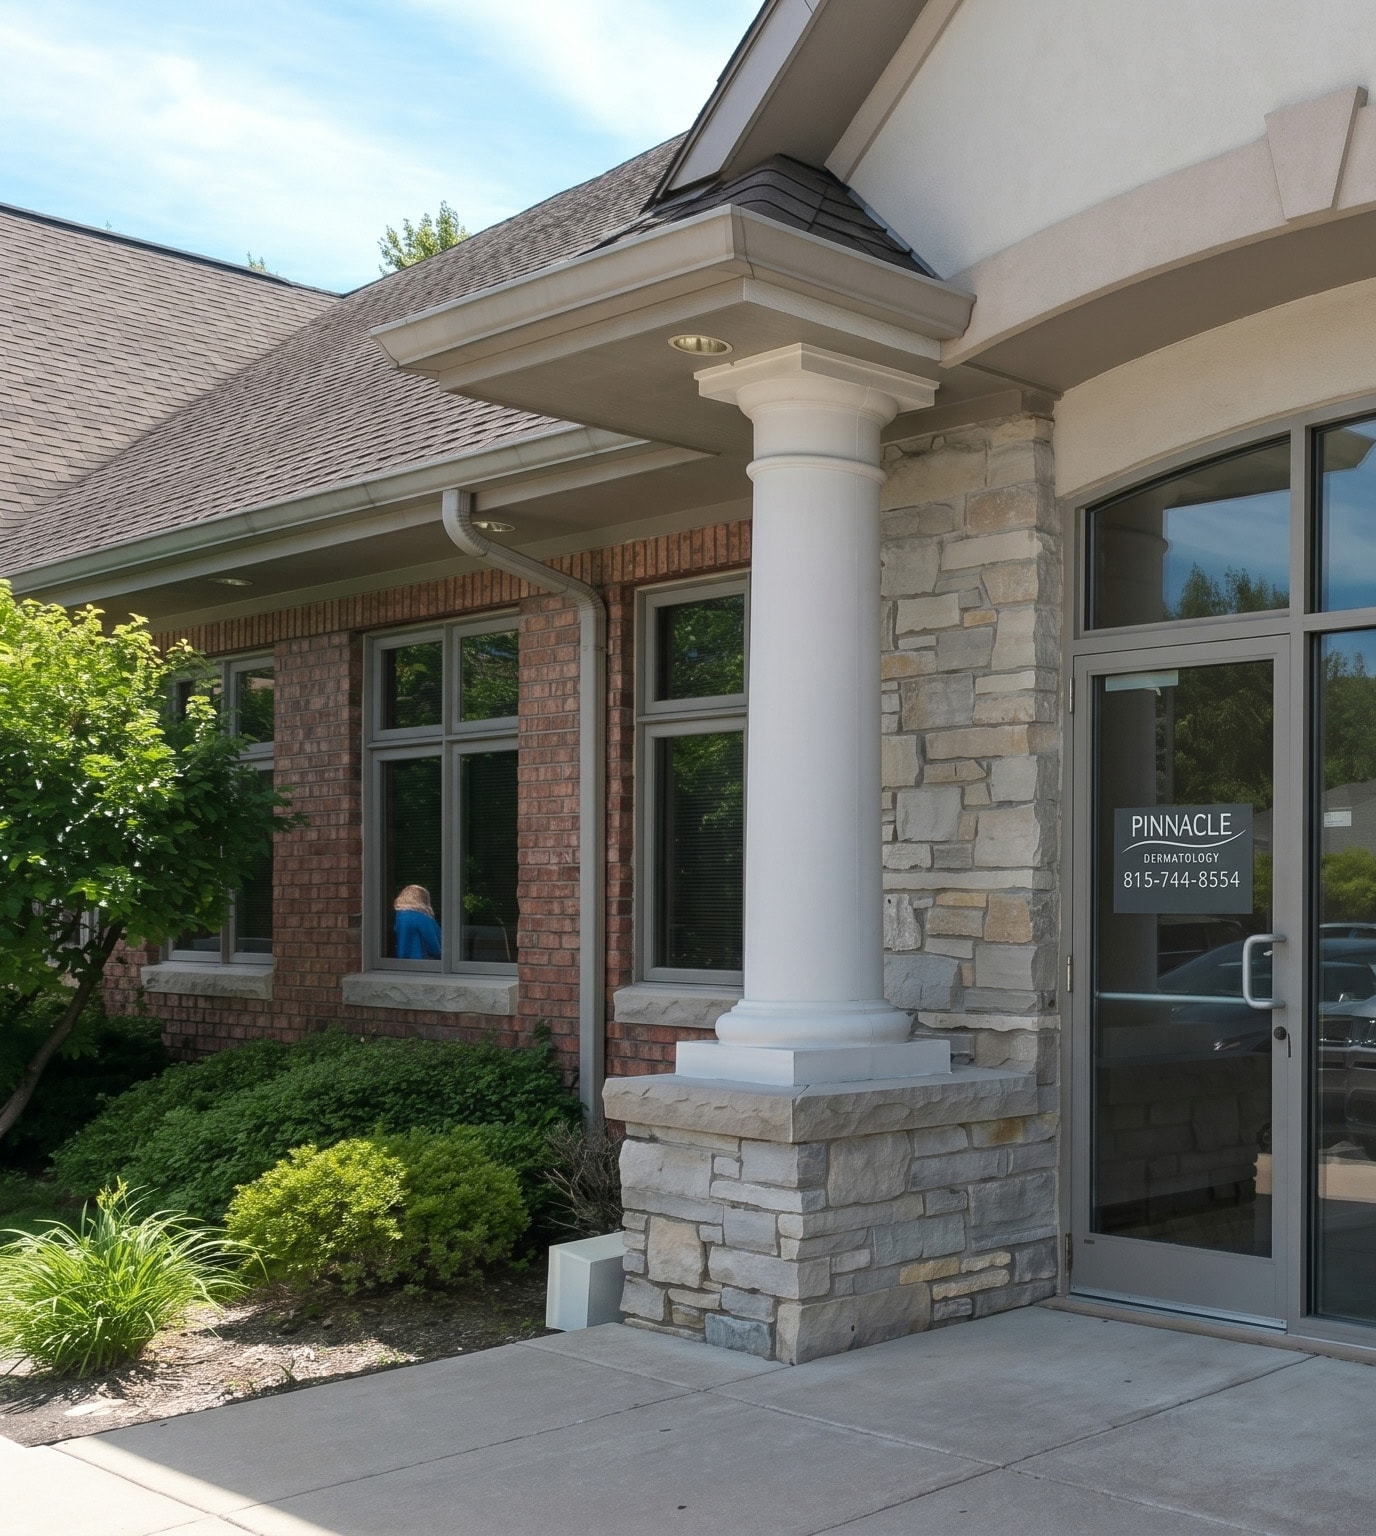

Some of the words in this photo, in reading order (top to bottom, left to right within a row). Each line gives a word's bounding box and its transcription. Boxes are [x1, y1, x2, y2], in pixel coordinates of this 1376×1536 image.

[1132, 813, 1232, 837] PINNACLE
[1143, 853, 1219, 863] DERMATOLOGY
[1123, 871, 1240, 888] 815-744-8554
